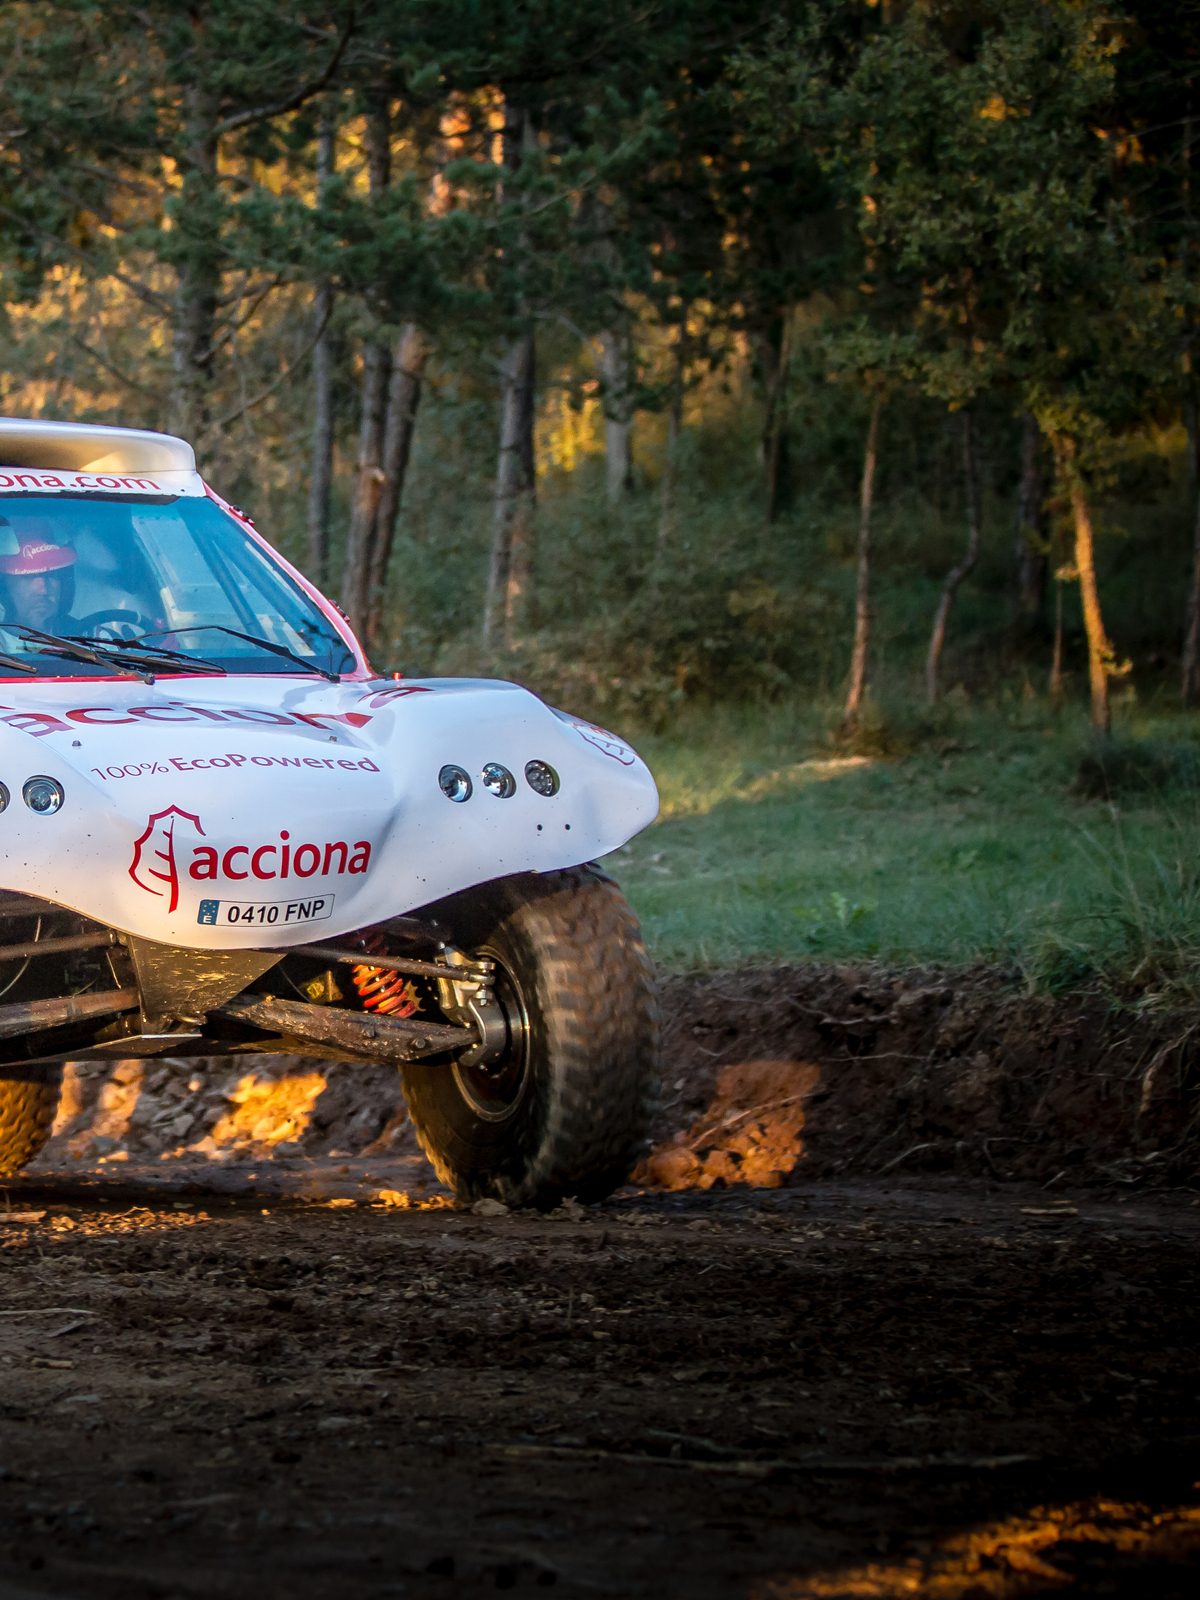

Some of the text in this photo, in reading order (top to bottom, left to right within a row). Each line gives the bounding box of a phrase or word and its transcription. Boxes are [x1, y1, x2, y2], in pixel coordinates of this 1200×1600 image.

[91, 753, 380, 780] 100% EcoPowered
[189, 830, 372, 880] acciona
[202, 900, 325, 924] E 0410 FNP
